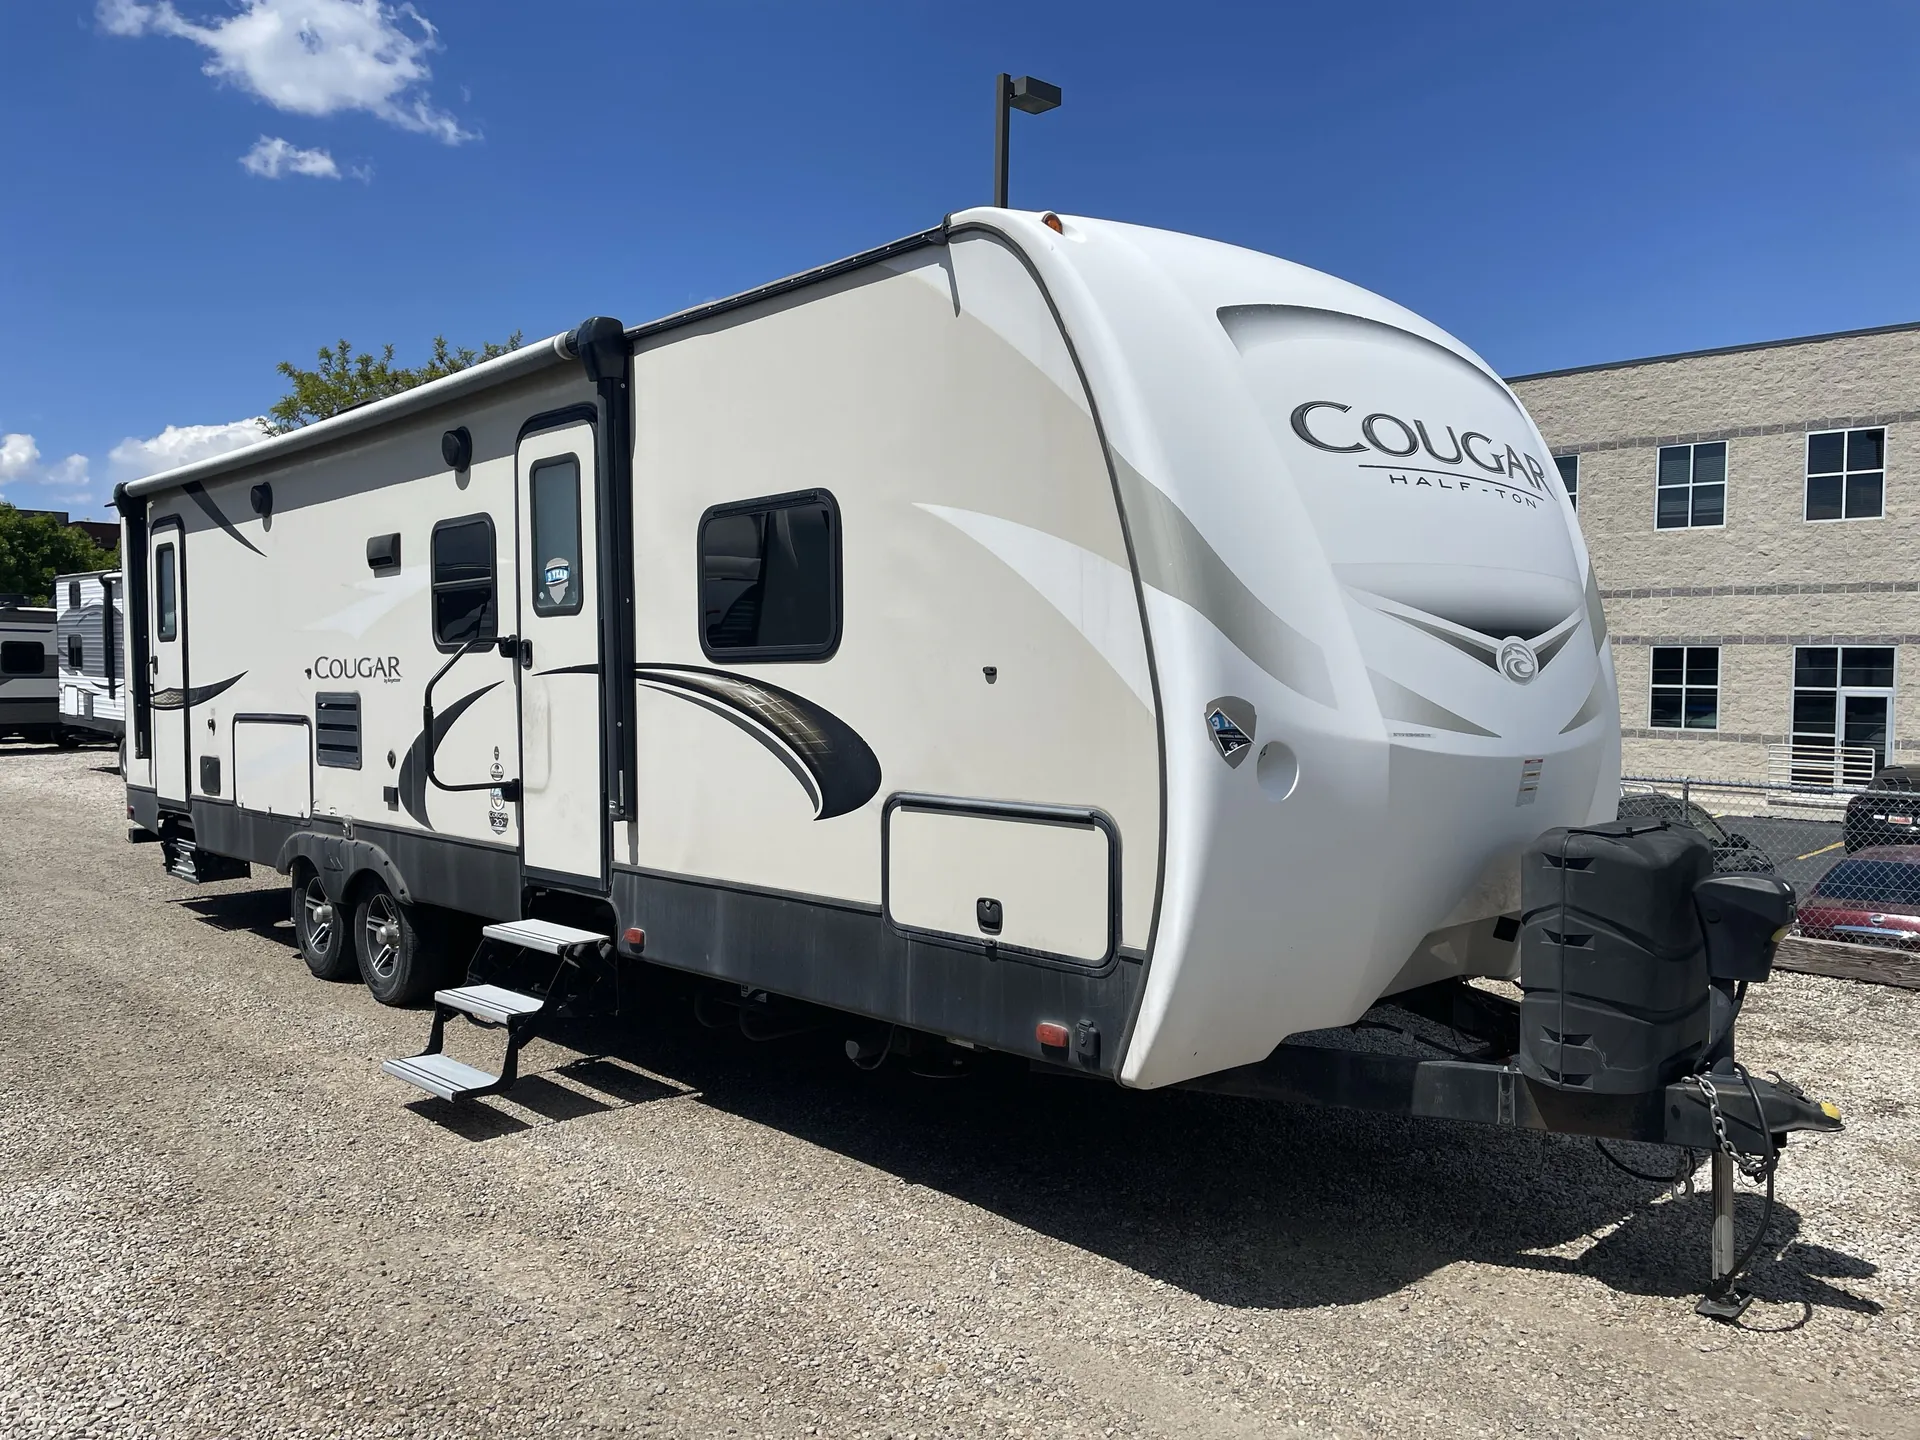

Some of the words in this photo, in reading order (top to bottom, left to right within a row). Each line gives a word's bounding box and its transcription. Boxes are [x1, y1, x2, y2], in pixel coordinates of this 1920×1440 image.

[1290, 400, 1558, 502] COUGAR
[1389, 474, 1537, 509] HALF-TON
[314, 656, 403, 679] COUGAR
[1211, 717, 1220, 730] 3
